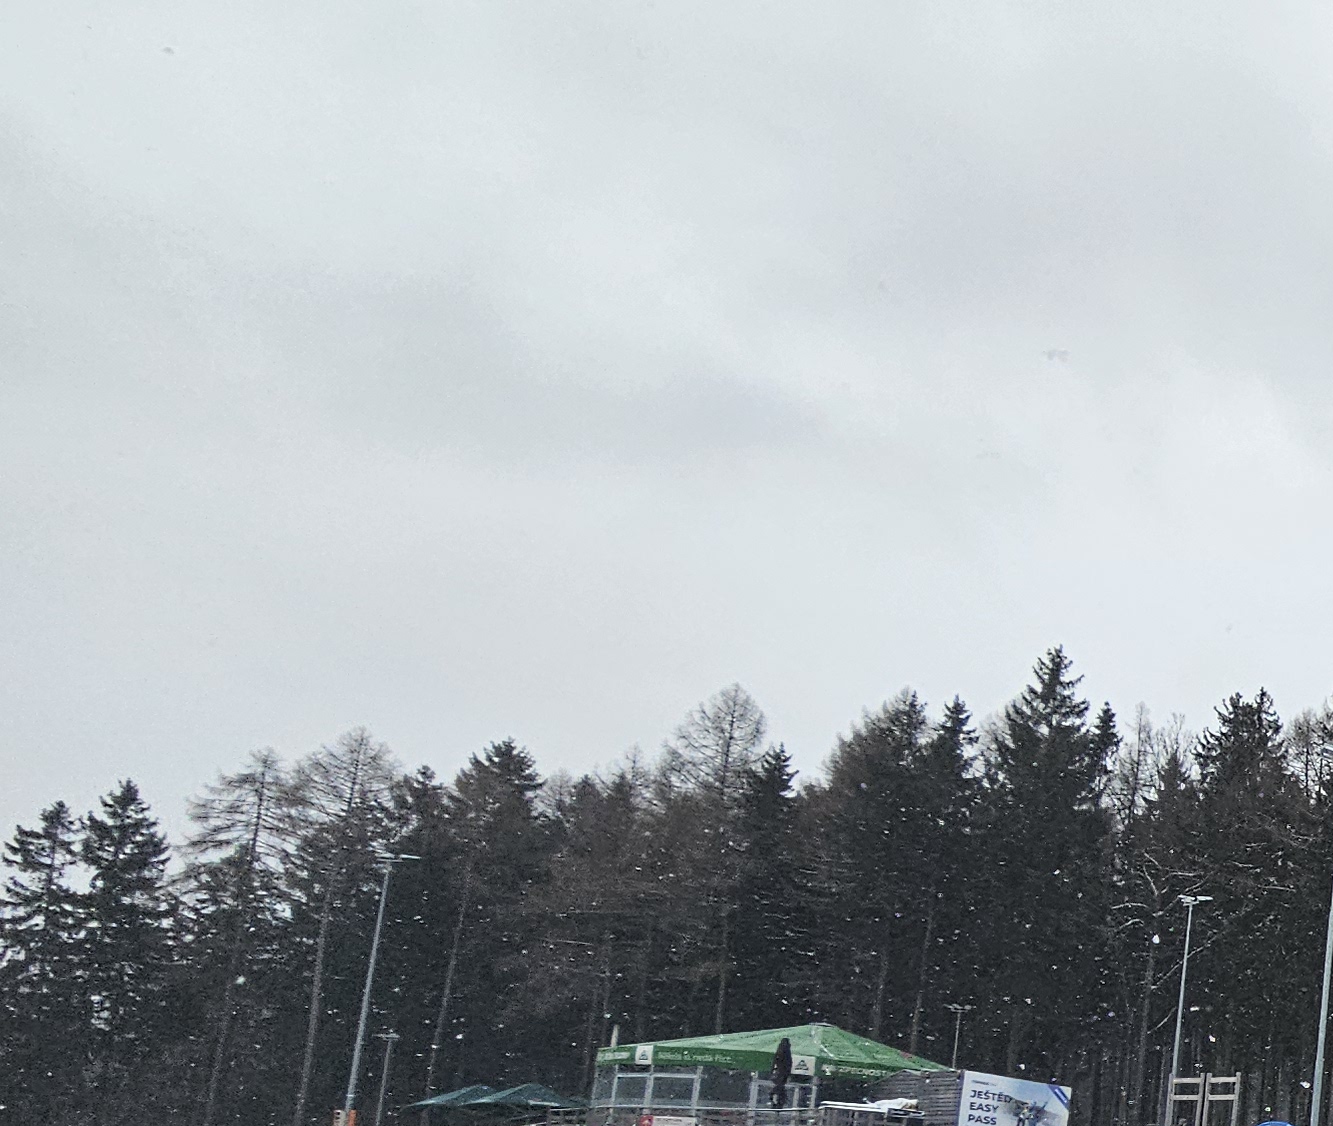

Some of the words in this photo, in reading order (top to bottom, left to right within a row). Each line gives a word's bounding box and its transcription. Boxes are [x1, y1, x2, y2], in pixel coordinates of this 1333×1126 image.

[969, 1088, 1013, 1104] JEŠTĚD
[969, 1101, 999, 1113] EASY
[967, 1113, 997, 1126] PASS
